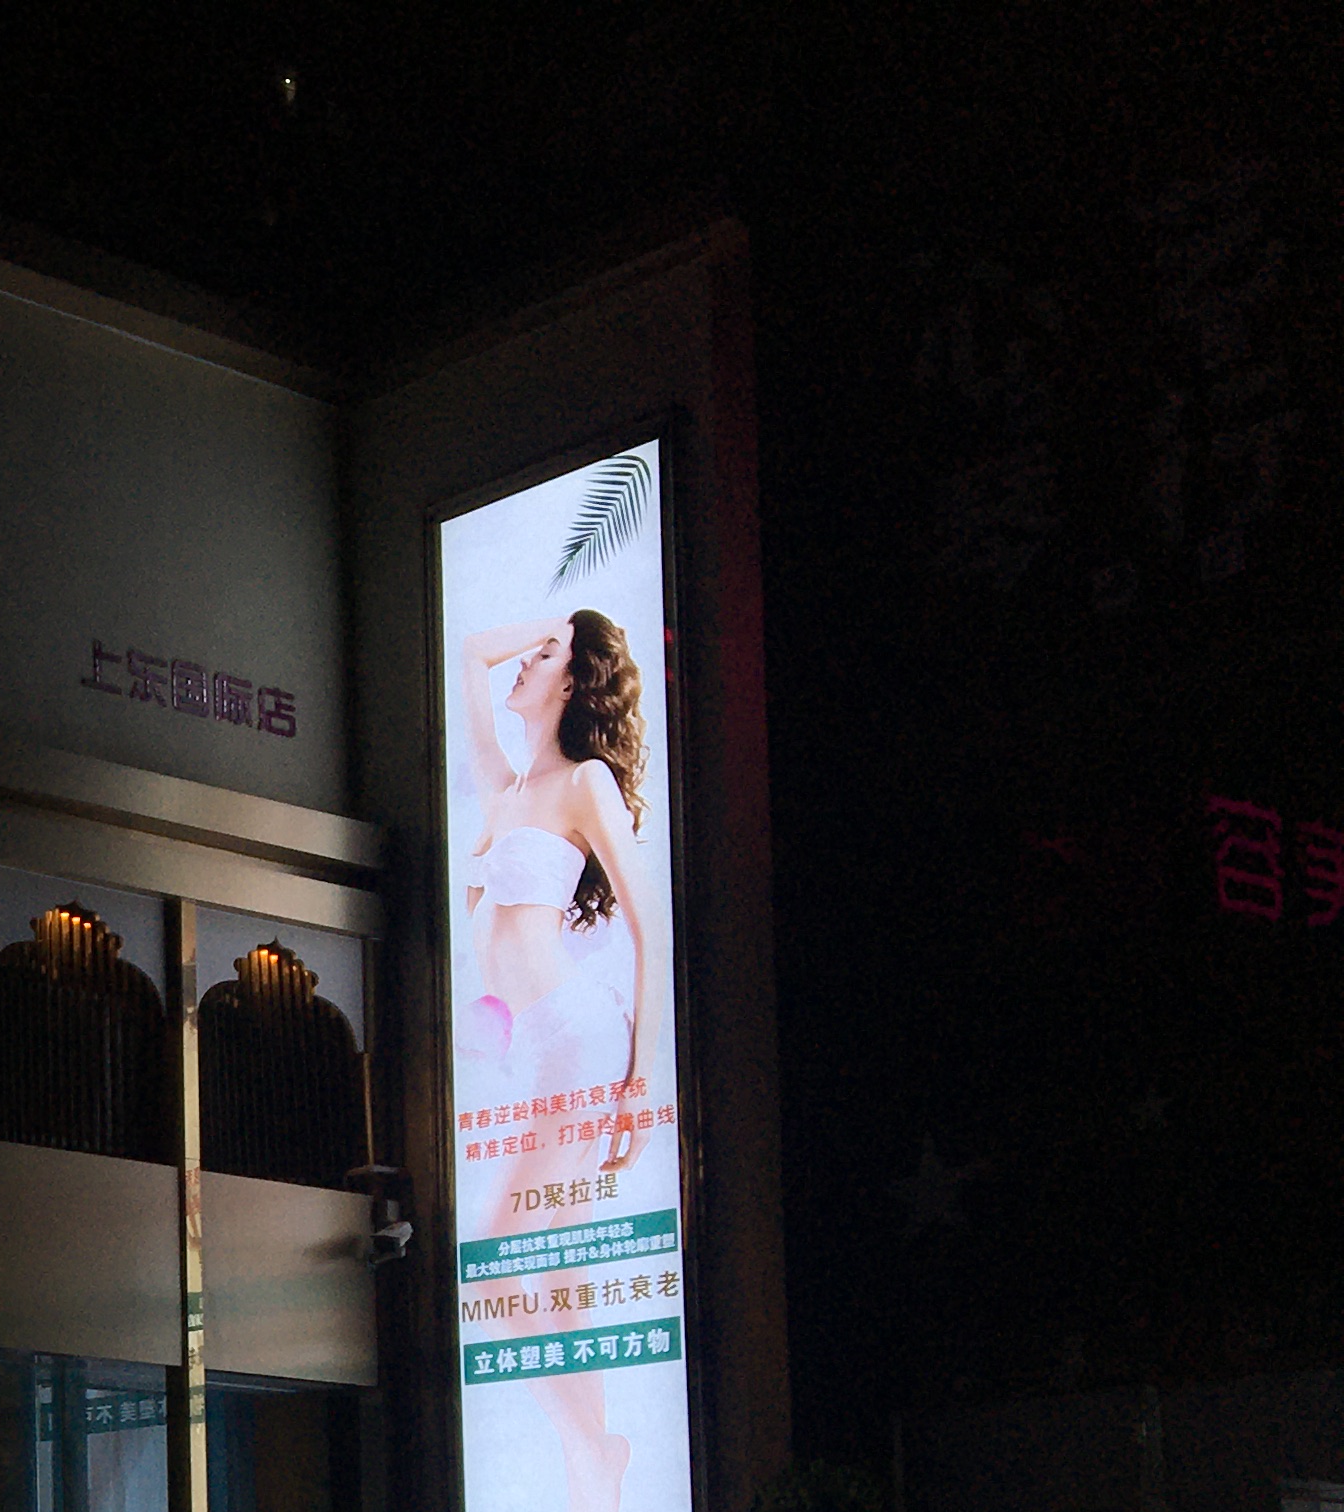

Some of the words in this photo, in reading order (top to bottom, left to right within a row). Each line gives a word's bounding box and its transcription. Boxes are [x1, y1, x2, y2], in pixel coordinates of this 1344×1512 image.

[510, 1172, 619, 1213] 7D聚拉提
[473, 1340, 565, 1376] 立体塑美
[574, 1327, 671, 1364] 不可方物
